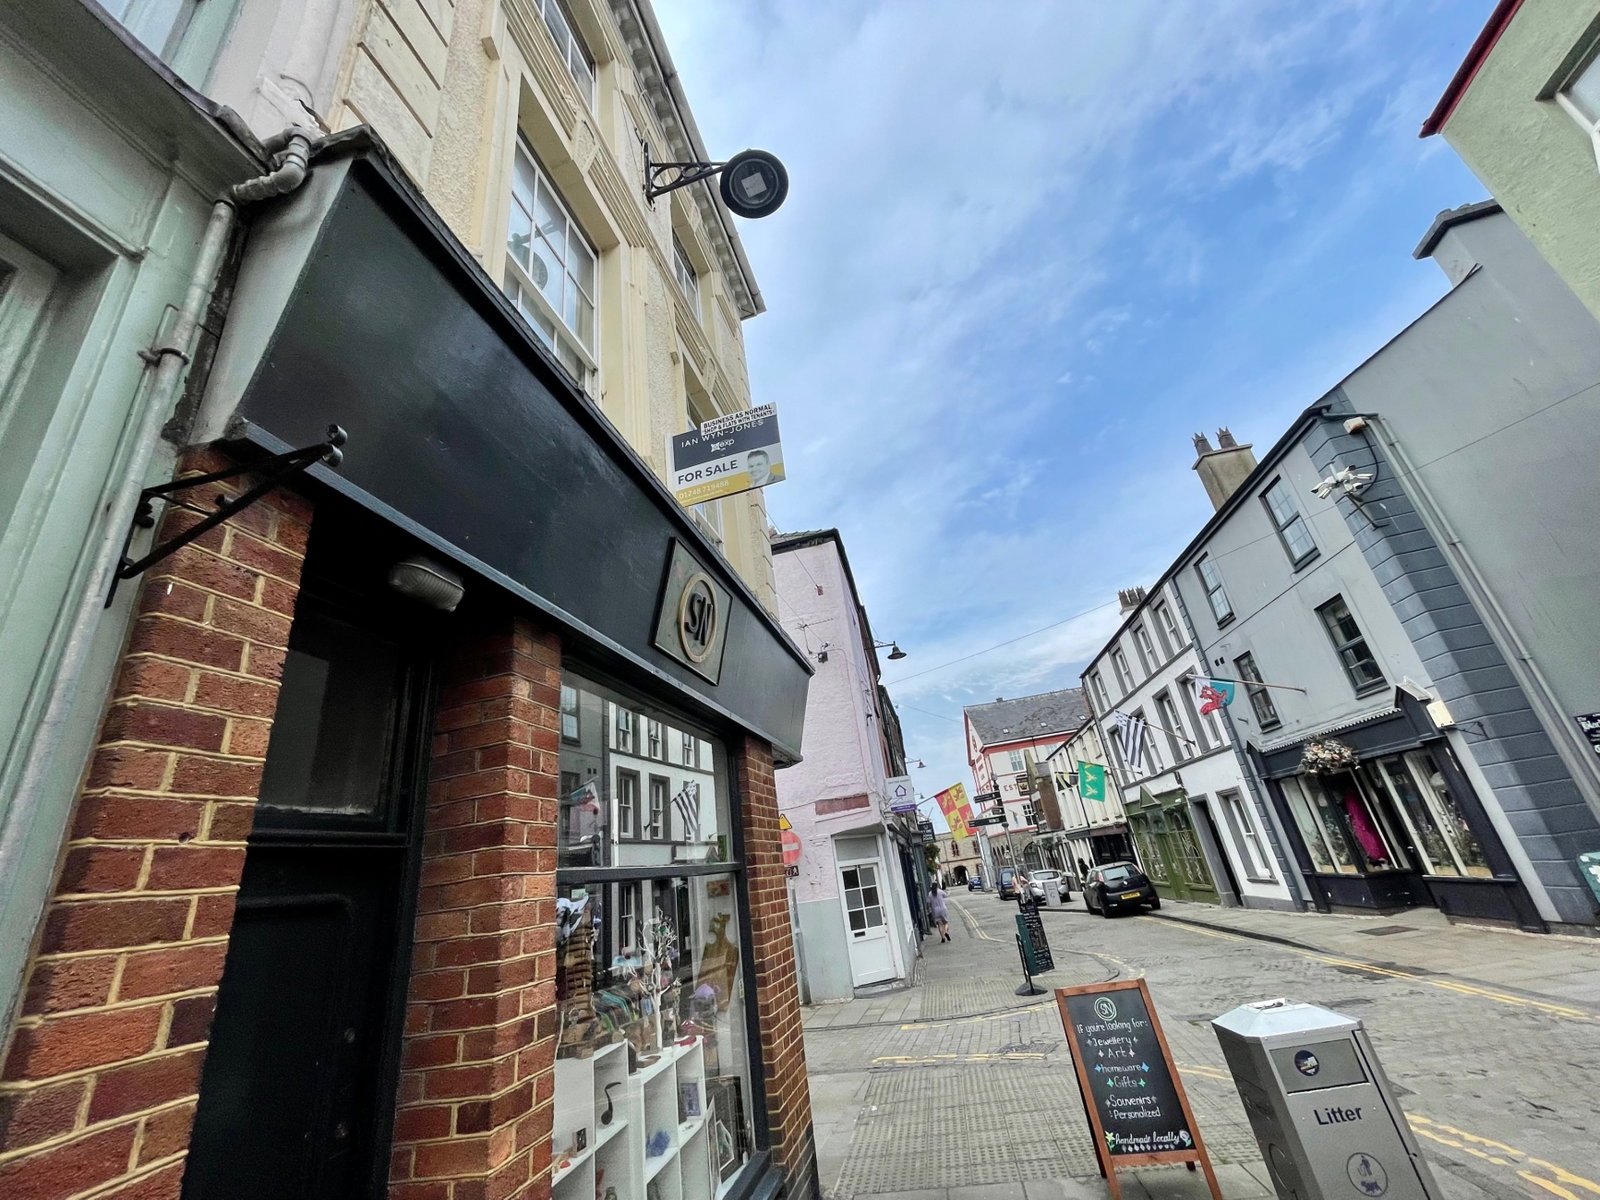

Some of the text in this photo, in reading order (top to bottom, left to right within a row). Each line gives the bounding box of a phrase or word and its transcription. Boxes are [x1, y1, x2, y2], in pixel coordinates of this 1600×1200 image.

[703, 404, 772, 428] BUSINESS AS NORMAL
[723, 419, 738, 428] FLATS
[738, 415, 751, 424] WITH
[681, 420, 764, 448] IAN WYN-JONES
[678, 459, 738, 485] FOR SALE
[685, 592, 714, 646] SN
[1100, 1002, 1114, 1016] SN
[1104, 1019, 1132, 1033] looking
[1092, 1036, 1133, 1048] Jewellery
[1108, 1046, 1128, 1059] Art
[1100, 1063, 1141, 1074] homeware
[1113, 1076, 1138, 1088] Gifts
[1109, 1094, 1152, 1108] Souvenirs
[1113, 1106, 1162, 1120] Personalized
[1313, 1106, 1363, 1125] Litter
[1152, 1131, 1179, 1144] locally
